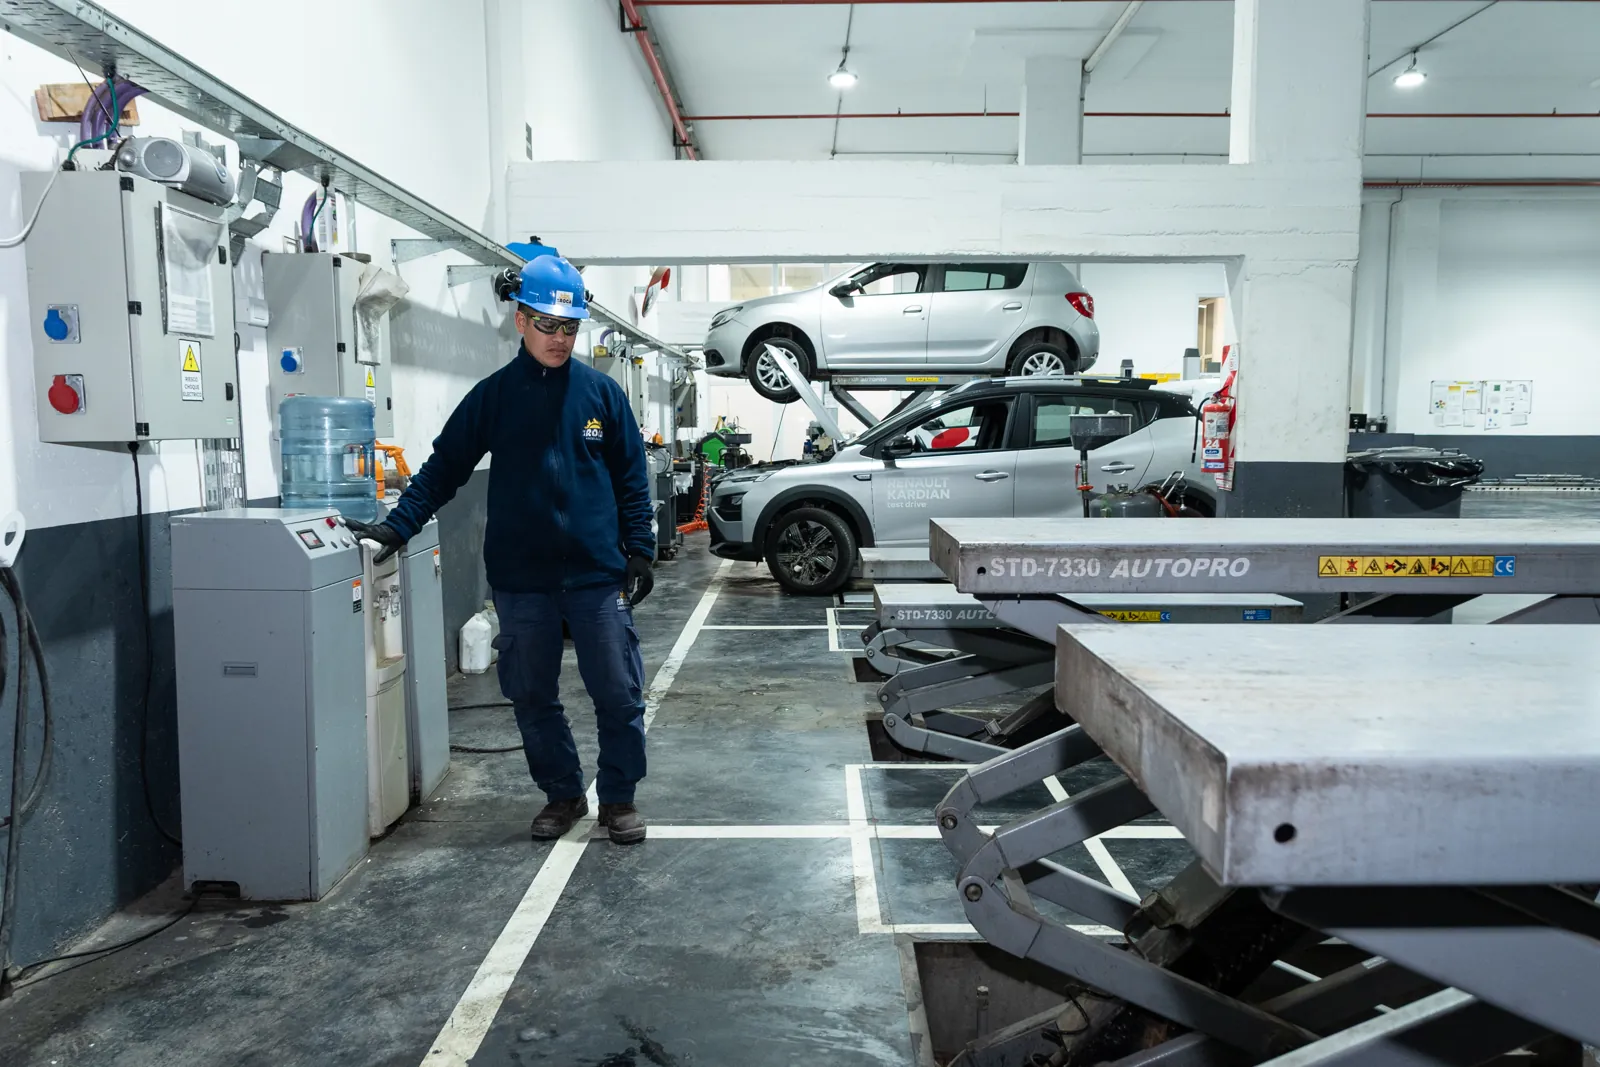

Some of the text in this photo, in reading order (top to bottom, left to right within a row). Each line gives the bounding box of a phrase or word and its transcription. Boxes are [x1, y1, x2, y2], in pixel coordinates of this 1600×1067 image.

[1205, 439, 1220, 448] 24
[886, 477, 950, 488] RENAULT
[886, 488, 950, 500] KARDIAN
[904, 500, 927, 508] drive
[990, 557, 1251, 579] STD-7330 AUTOPRO
[1495, 560, 1514, 573] CE
[897, 609, 953, 620] STD-7330
